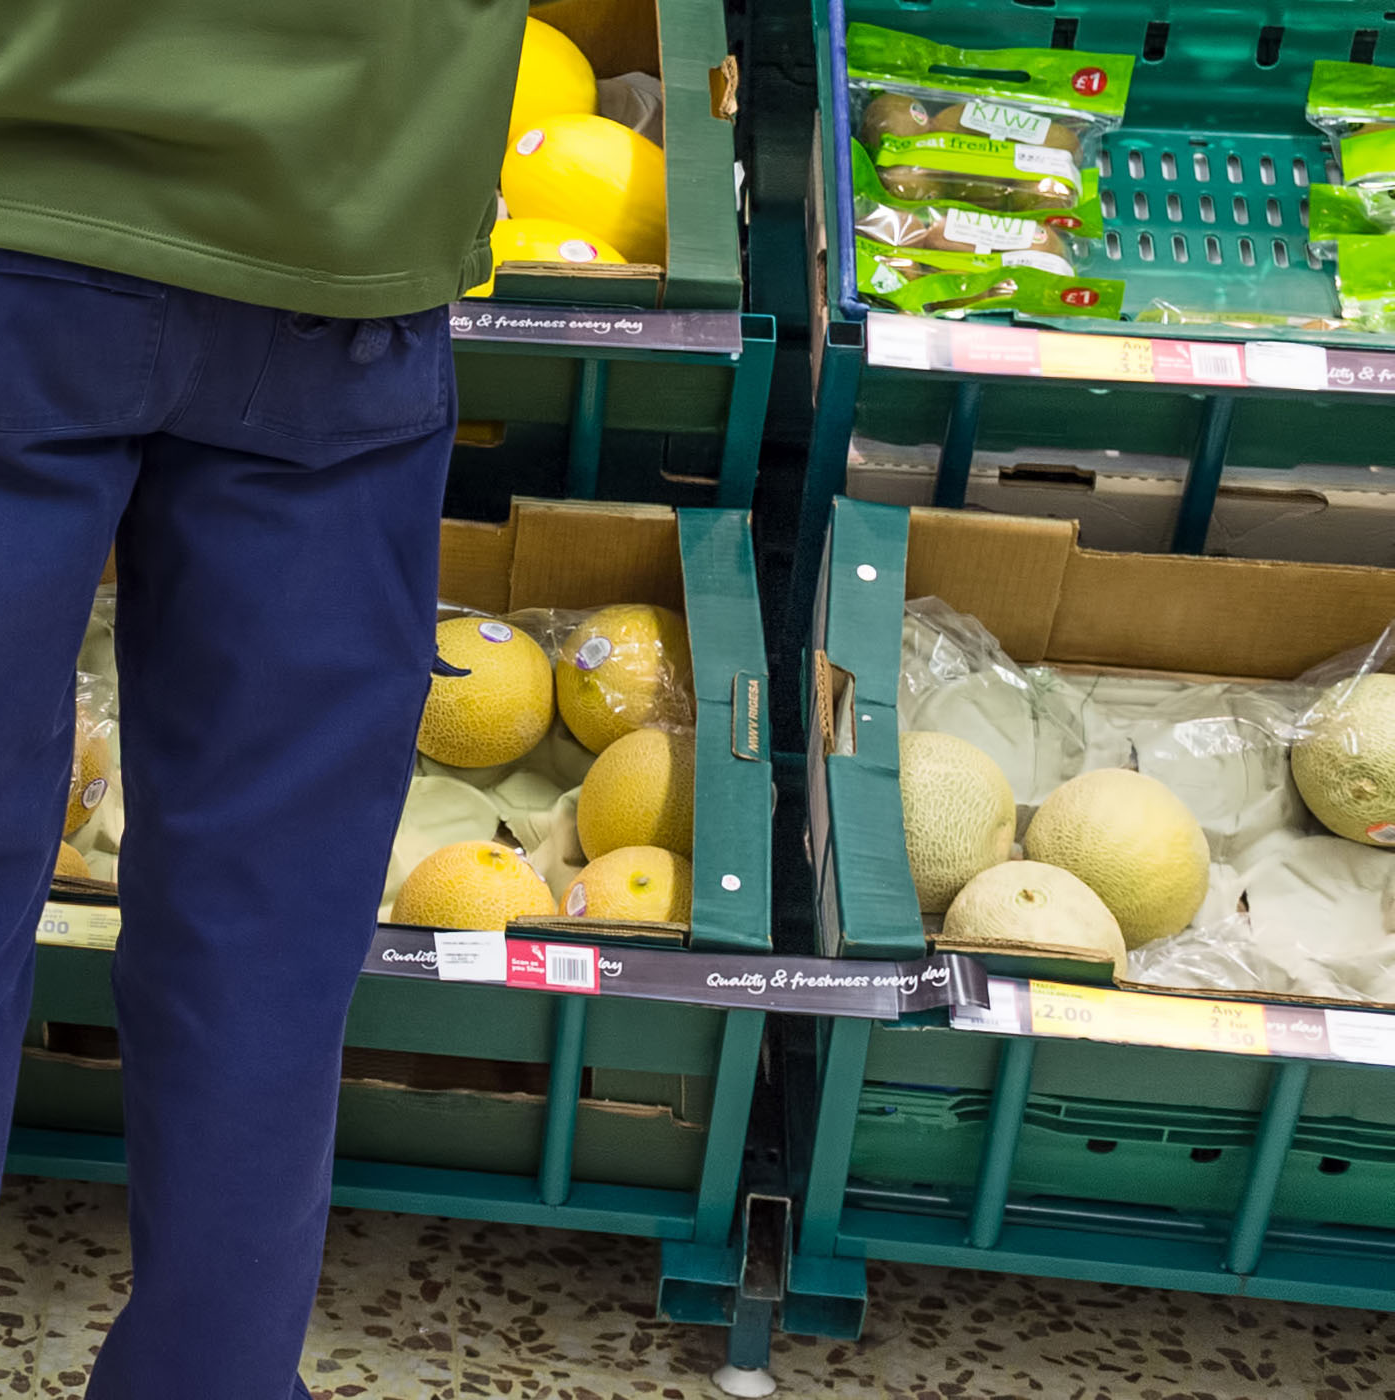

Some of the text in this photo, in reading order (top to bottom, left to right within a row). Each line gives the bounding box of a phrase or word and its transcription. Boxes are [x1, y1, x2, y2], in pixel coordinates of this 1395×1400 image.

[1074, 71, 1102, 92] £1
[971, 102, 1042, 132] KIWI
[915, 136, 1001, 153] eat fresh
[1064, 291, 1092, 305] £1
[746, 679, 760, 753] MWV RIGESA
[511, 958, 530, 967] Scan
[511, 965, 545, 974] you Shop
[706, 966, 951, 994] Quality & freshness every day
[1034, 1004, 1092, 1023] £2.00
